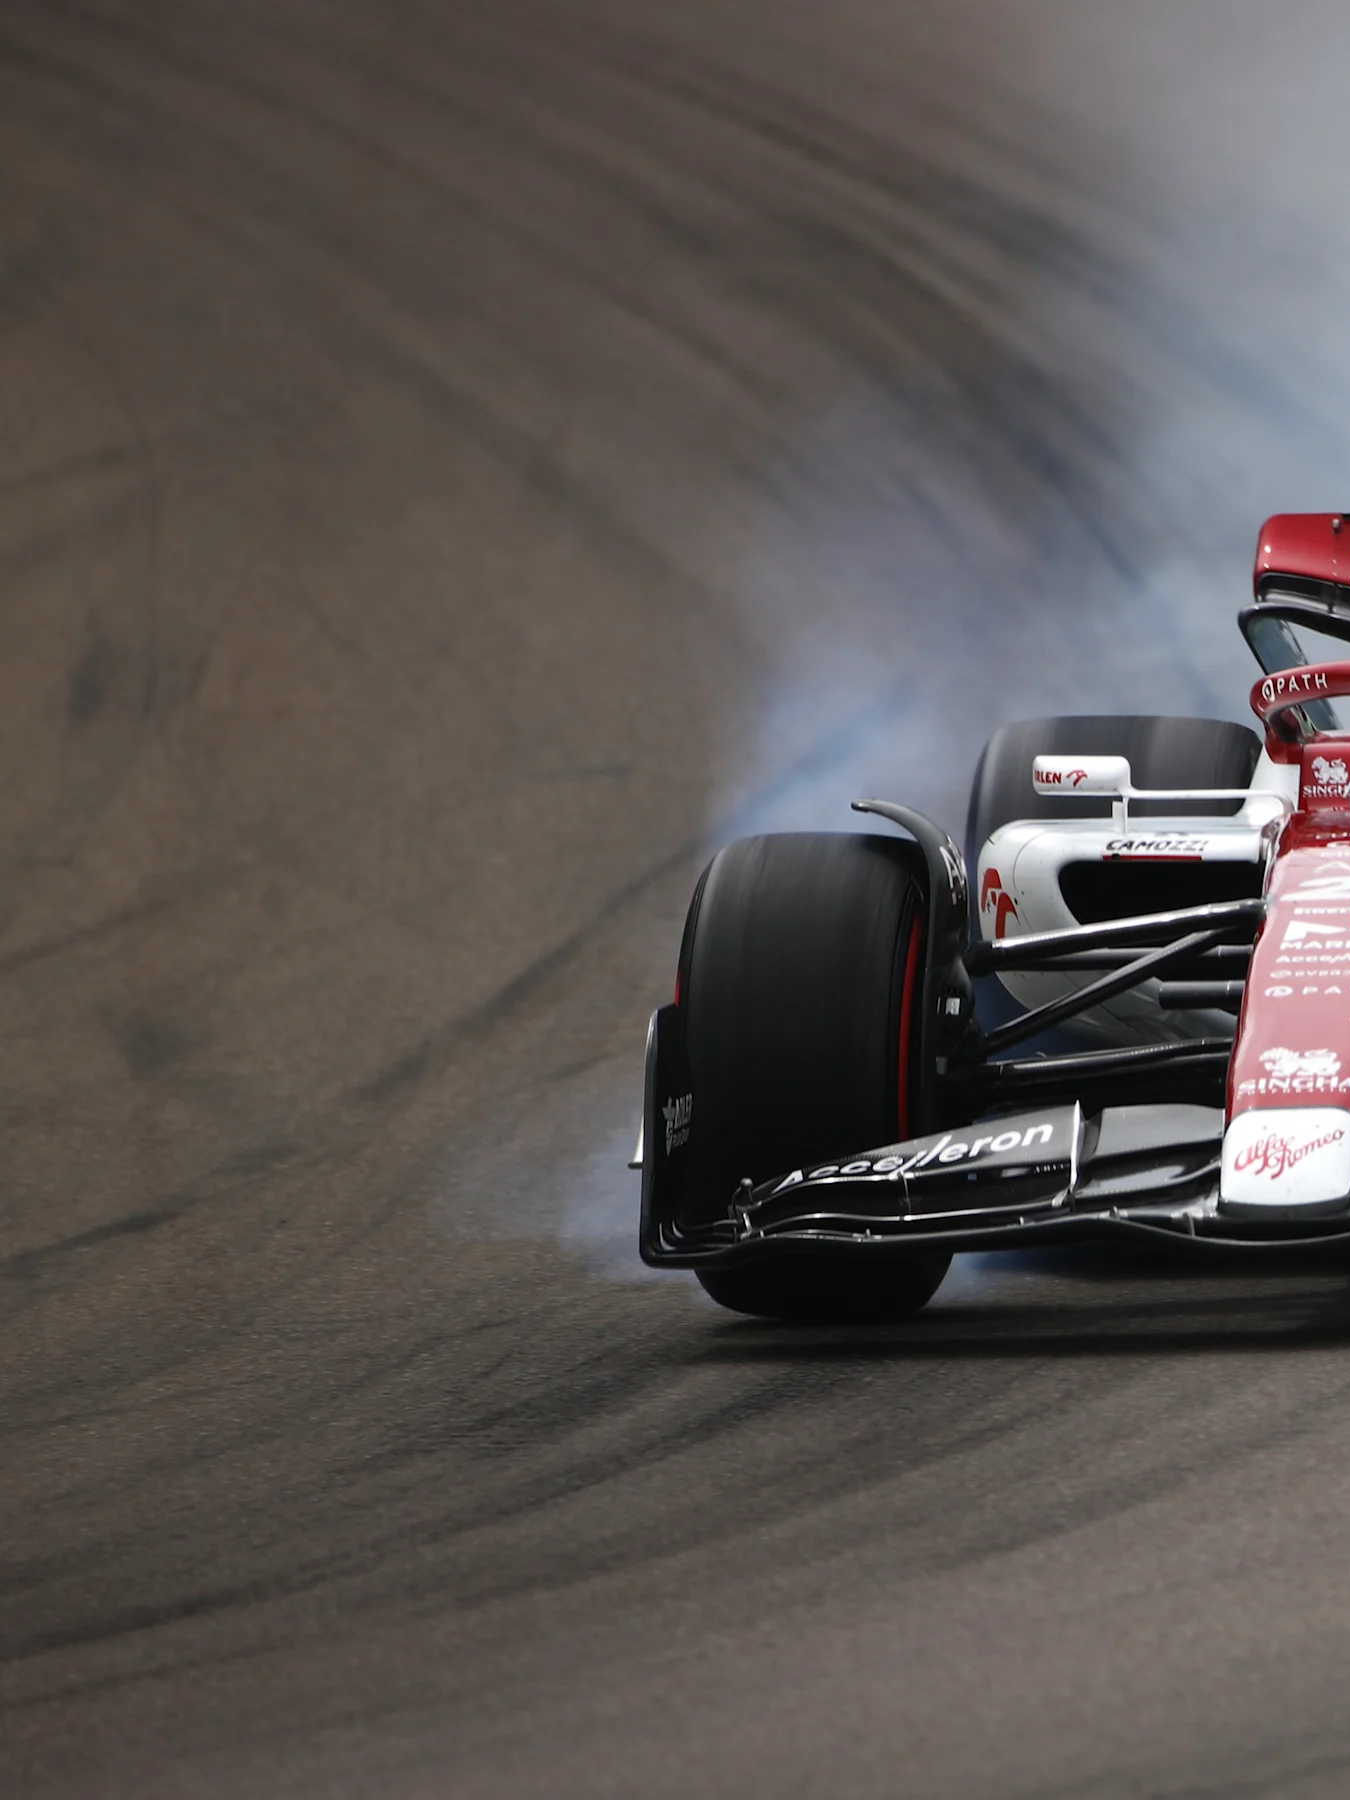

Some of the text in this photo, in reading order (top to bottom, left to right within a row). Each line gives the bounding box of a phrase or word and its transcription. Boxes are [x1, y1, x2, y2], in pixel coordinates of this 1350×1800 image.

[1277, 673, 1328, 694] PATH
[1034, 770, 1062, 784] RLEN
[1106, 838, 1209, 852] CAMOZZI
[771, 1123, 1054, 1195] Accelleron
[1234, 1133, 1287, 1175] Alfa
[1266, 1129, 1345, 1179] Romeo
